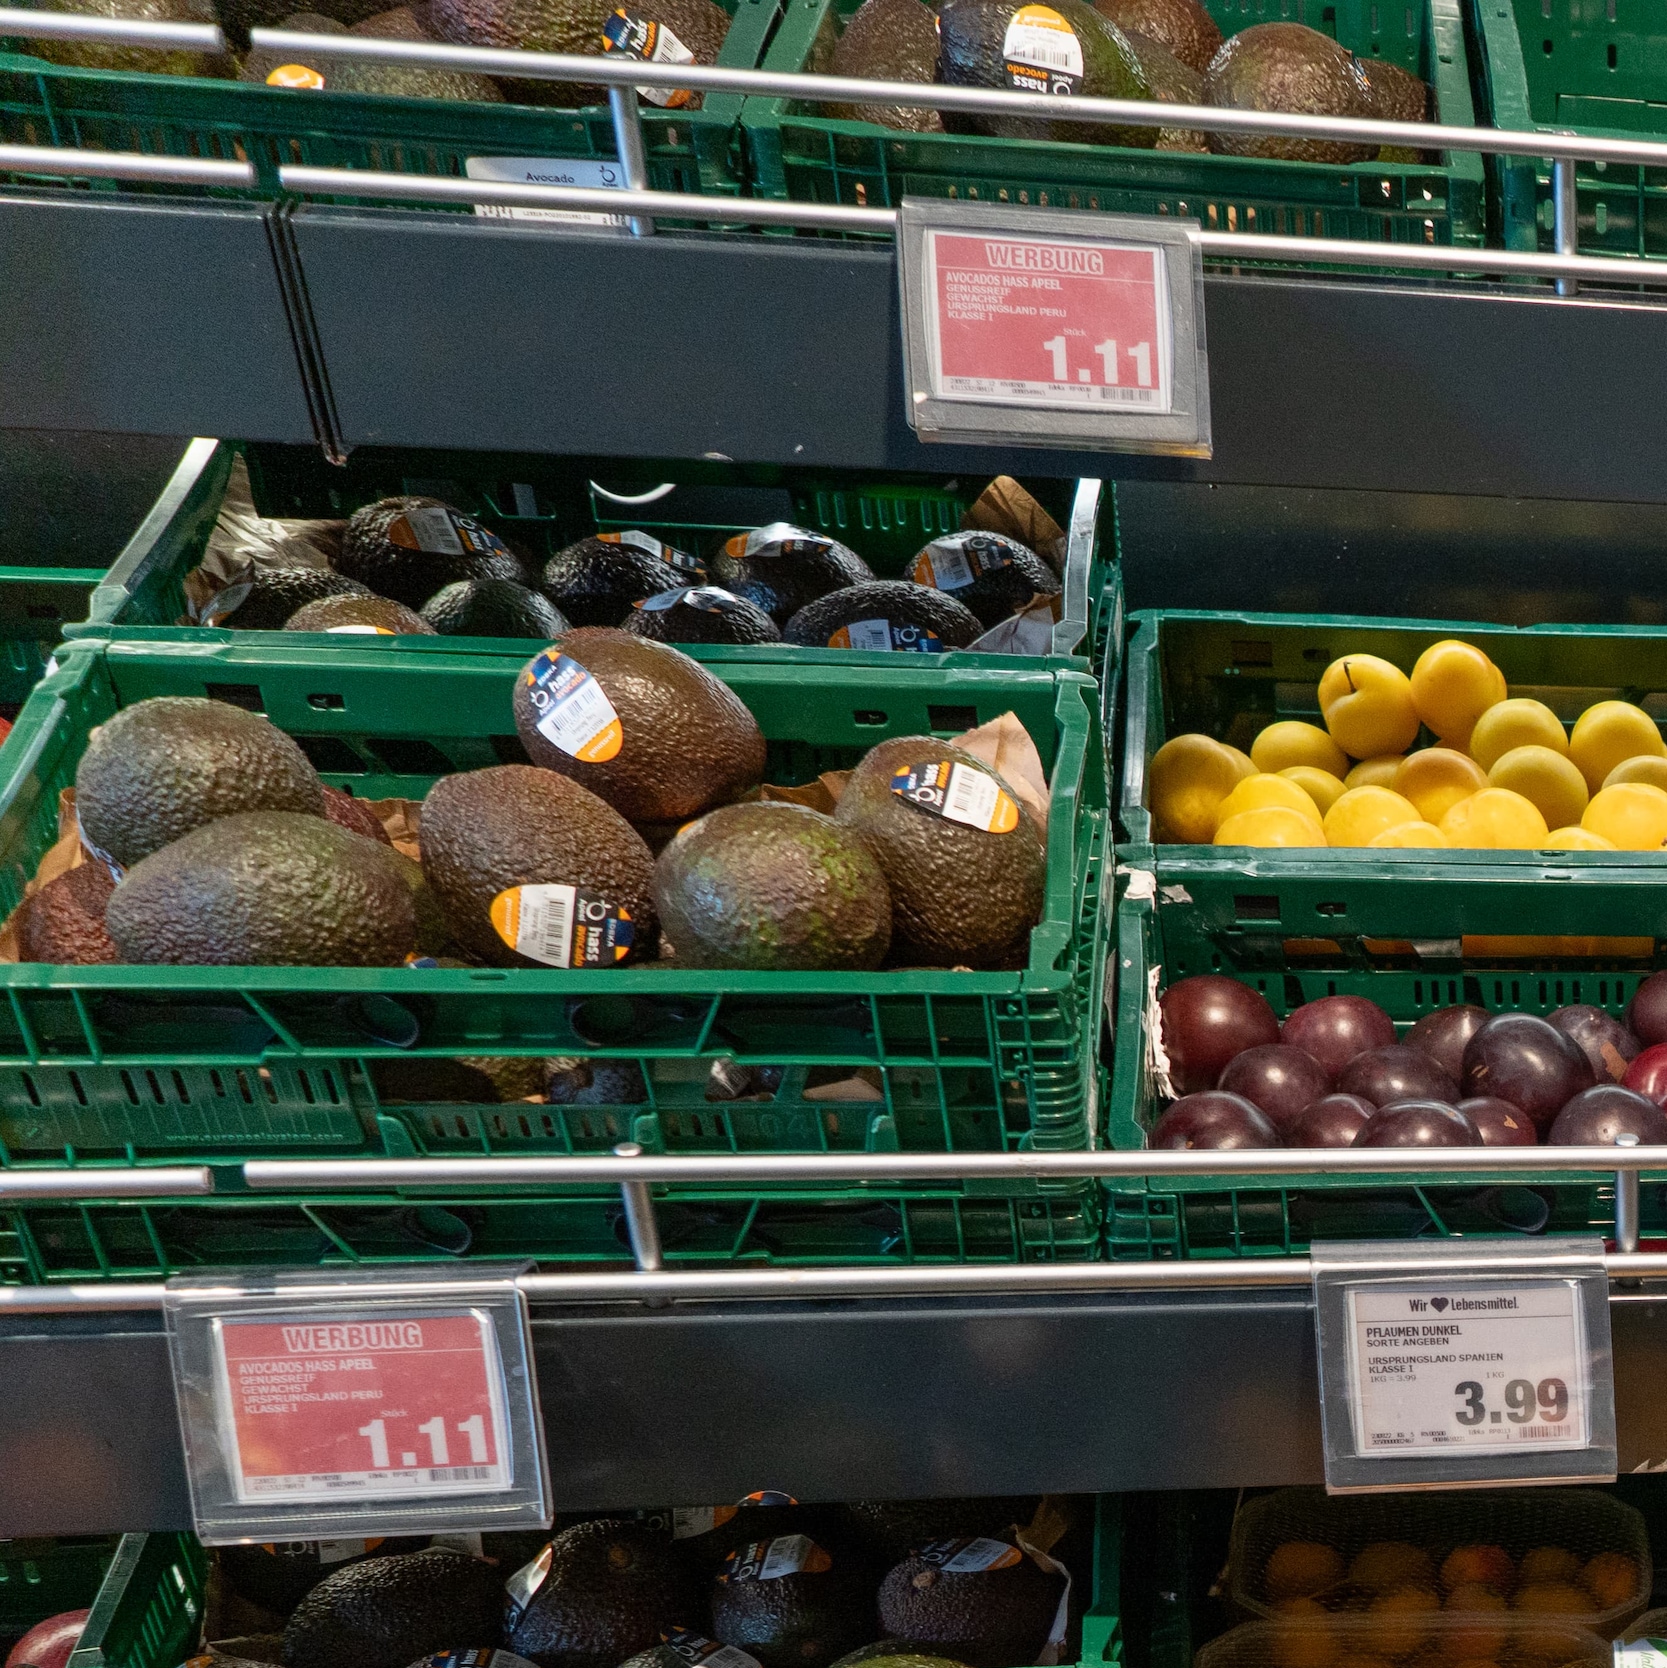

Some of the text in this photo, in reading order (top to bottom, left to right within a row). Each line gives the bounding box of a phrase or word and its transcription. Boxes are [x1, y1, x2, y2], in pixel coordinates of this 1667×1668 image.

[1008, 63, 1048, 79] avocado
[1013, 75, 1046, 94] hass
[527, 172, 575, 184] Avocado
[985, 243, 1103, 275] WERBUNG
[946, 271, 1063, 291] AVOCADOS HASS APEEL
[947, 284, 1011, 297] GENUSSREIF
[947, 293, 1004, 305] GEWACHST
[947, 301, 1066, 318] URSPRUNGSLAND PERU
[948, 310, 983, 322] KLASSE
[1043, 334, 1152, 389] 1.11
[1409, 1299, 1429, 1311] Wir
[282, 1322, 422, 1353] WERBUNG
[1366, 1325, 1462, 1338] PFLAUMEN DUNKEL
[1366, 1337, 1450, 1348] SORTE ANGEBEN
[1368, 1353, 1504, 1366] URSPRUNGSLAND SPANIEN
[239, 1358, 376, 1375] AVOCADOS HASS APEEL
[1369, 1365, 1405, 1375] KLASSE
[240, 1374, 315, 1385] GENUSSREIF
[242, 1383, 308, 1395] GEWACHST
[244, 1389, 384, 1404] URSPRUNGSLAND PERU
[1455, 1378, 1569, 1426] 3.99
[245, 1403, 287, 1414] KLASSE
[360, 1414, 488, 1469] 1.11
